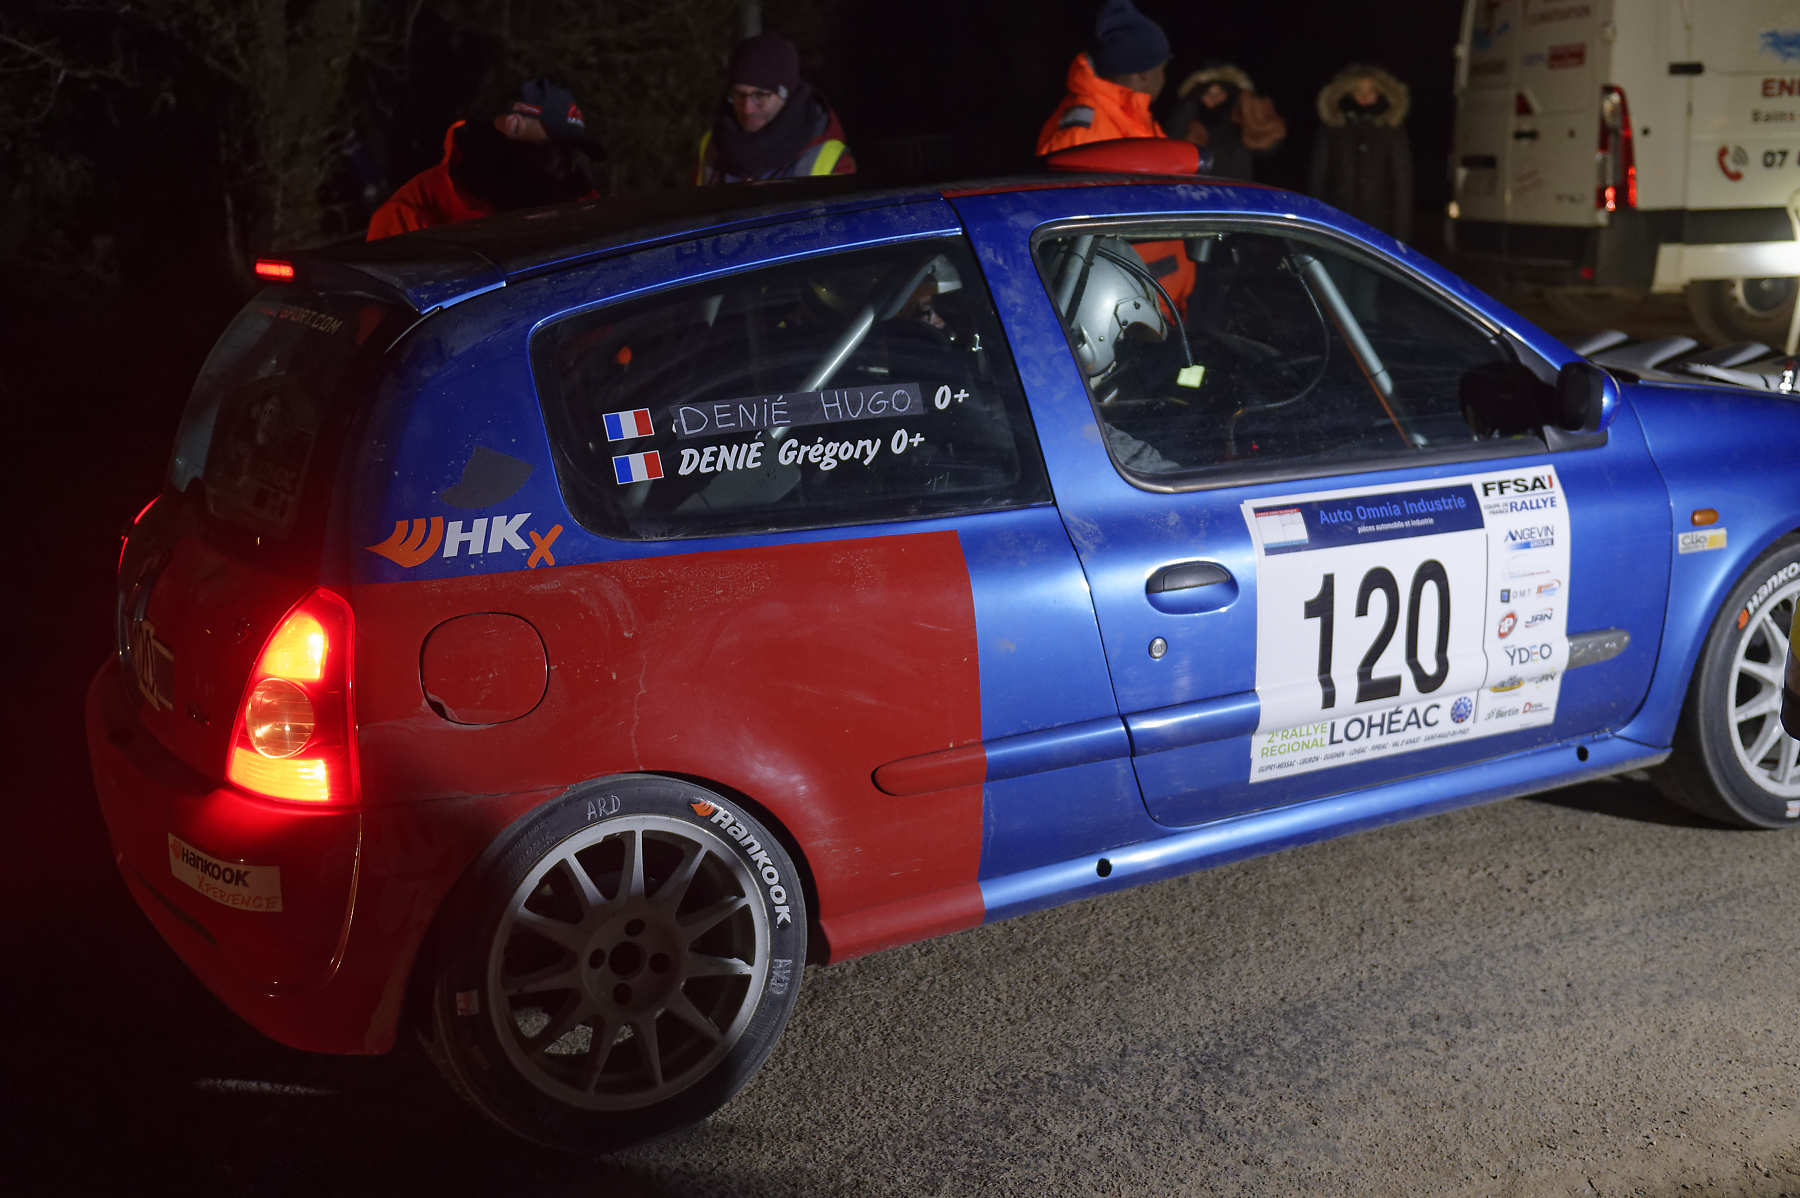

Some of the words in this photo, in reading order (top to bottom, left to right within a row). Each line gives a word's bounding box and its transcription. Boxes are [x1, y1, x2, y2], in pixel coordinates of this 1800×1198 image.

[1763, 78, 1800, 98] EN
[1763, 149, 1788, 169] 07
[821, 389, 911, 421] HUGO
[679, 431, 764, 475] DENIÉ
[778, 436, 881, 471] Grégory
[1482, 475, 1548, 496] FFSA
[1320, 509, 1353, 525] Auto
[1356, 502, 1401, 520] Omnia
[1404, 494, 1467, 514] Industrie
[1510, 496, 1557, 512] RALLYE
[1504, 525, 1555, 543] ANGEVIN
[1304, 559, 1450, 709] 120
[1281, 722, 1328, 741] RALLYE
[1328, 704, 1440, 745] LOHÉAC
[586, 794, 621, 820] ARD
